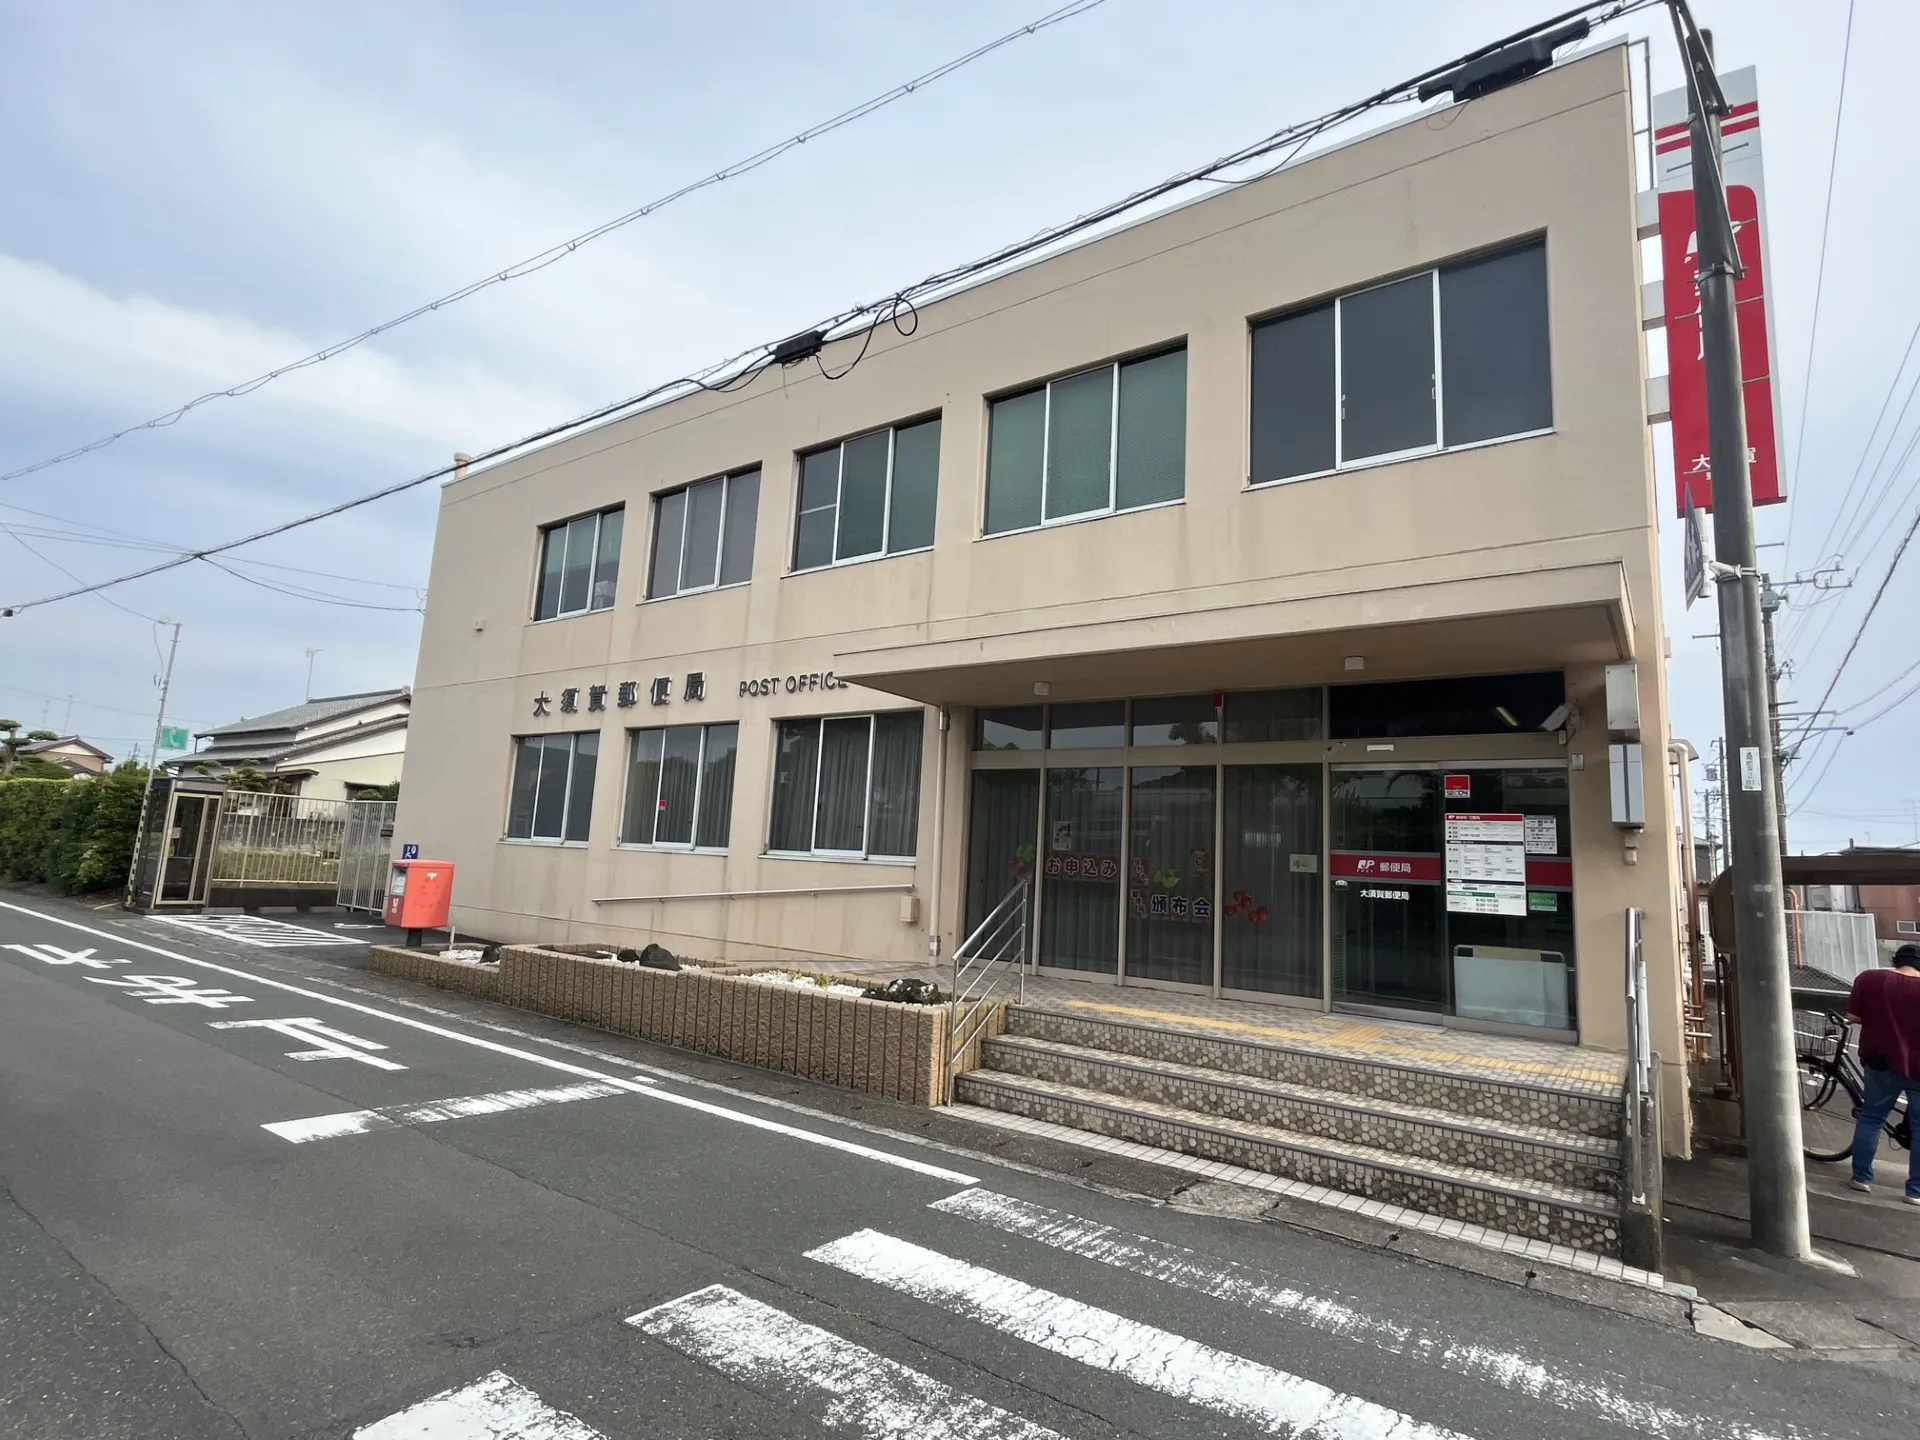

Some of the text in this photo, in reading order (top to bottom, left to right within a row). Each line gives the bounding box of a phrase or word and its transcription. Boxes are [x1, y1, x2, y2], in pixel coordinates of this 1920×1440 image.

[532, 671, 706, 717] 大須賀郵便局
[739, 677, 781, 697] POST
[1045, 857, 1117, 878] お申込み
[1380, 862, 1411, 873] 郵便局
[1150, 893, 1212, 917] 頒布会
[1360, 889, 1410, 901] 大須賀郵便局
